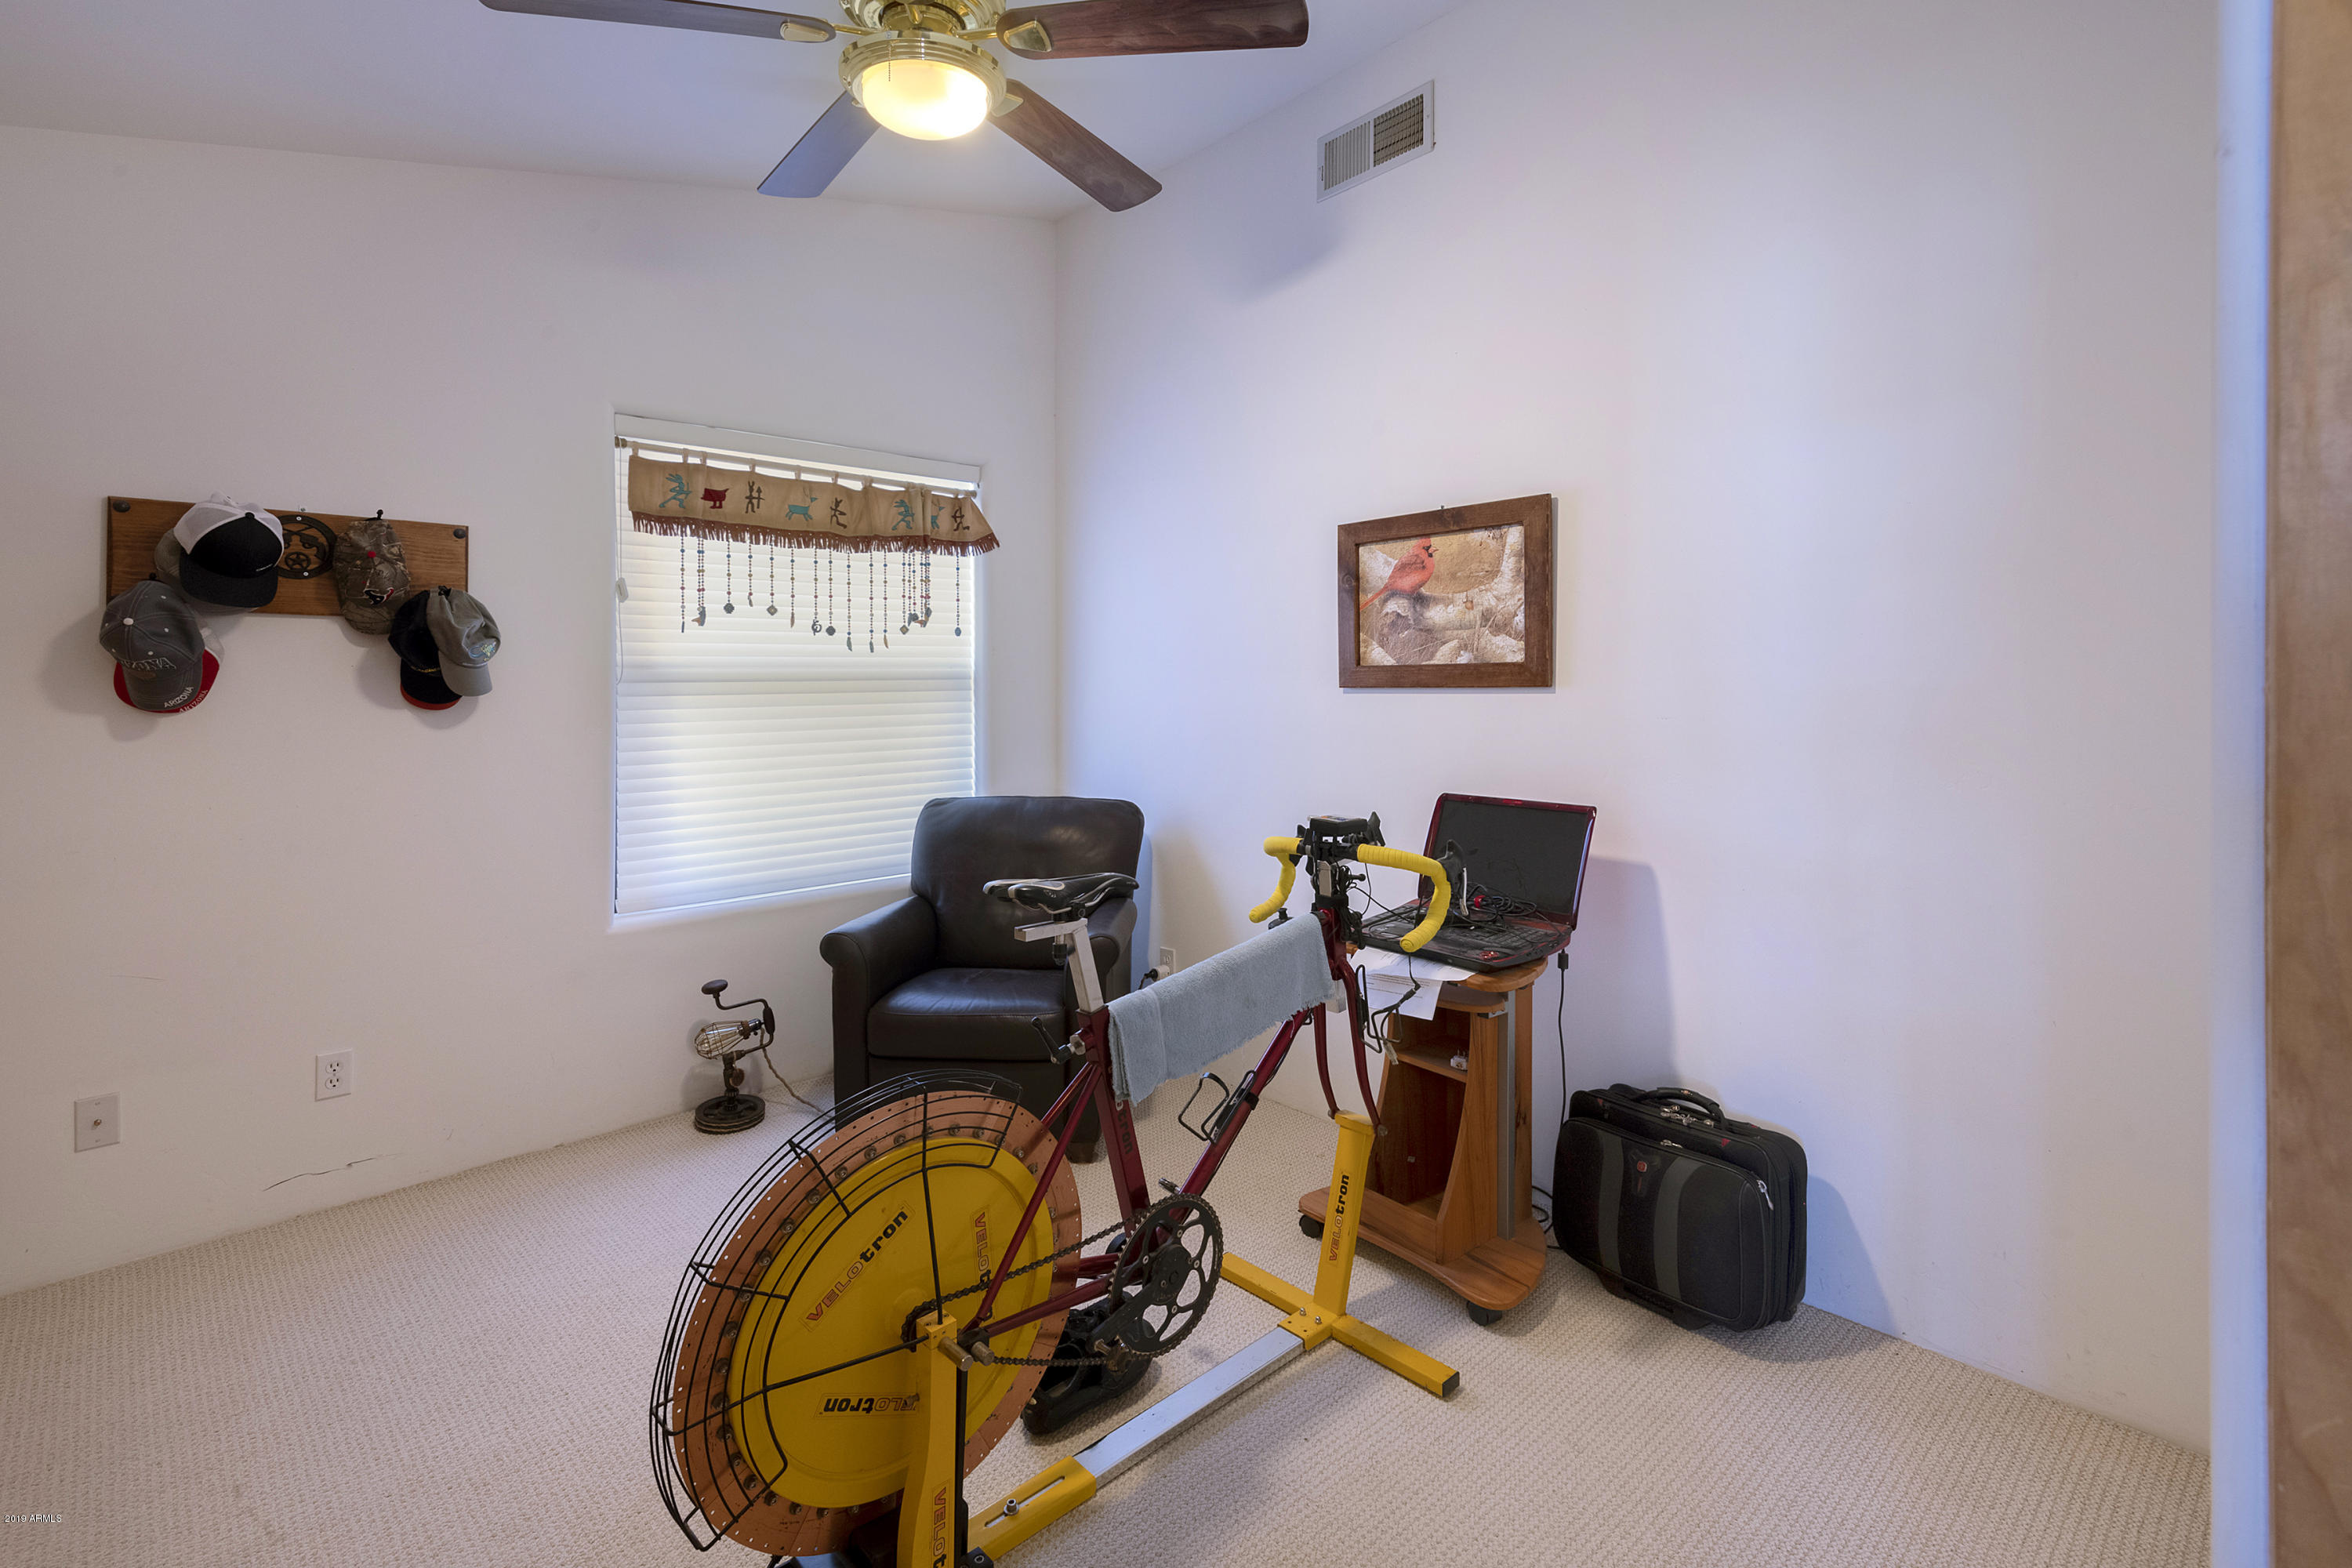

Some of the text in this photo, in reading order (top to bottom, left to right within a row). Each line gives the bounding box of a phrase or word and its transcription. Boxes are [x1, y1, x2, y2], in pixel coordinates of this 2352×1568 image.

[164, 686, 194, 709] ARIZONA
[179, 689, 209, 713] ARIZONA
[1329, 1174, 1349, 1261] VELOtron
[806, 1210, 909, 1321] VELOtron
[823, 1397, 916, 1414] LOtron
